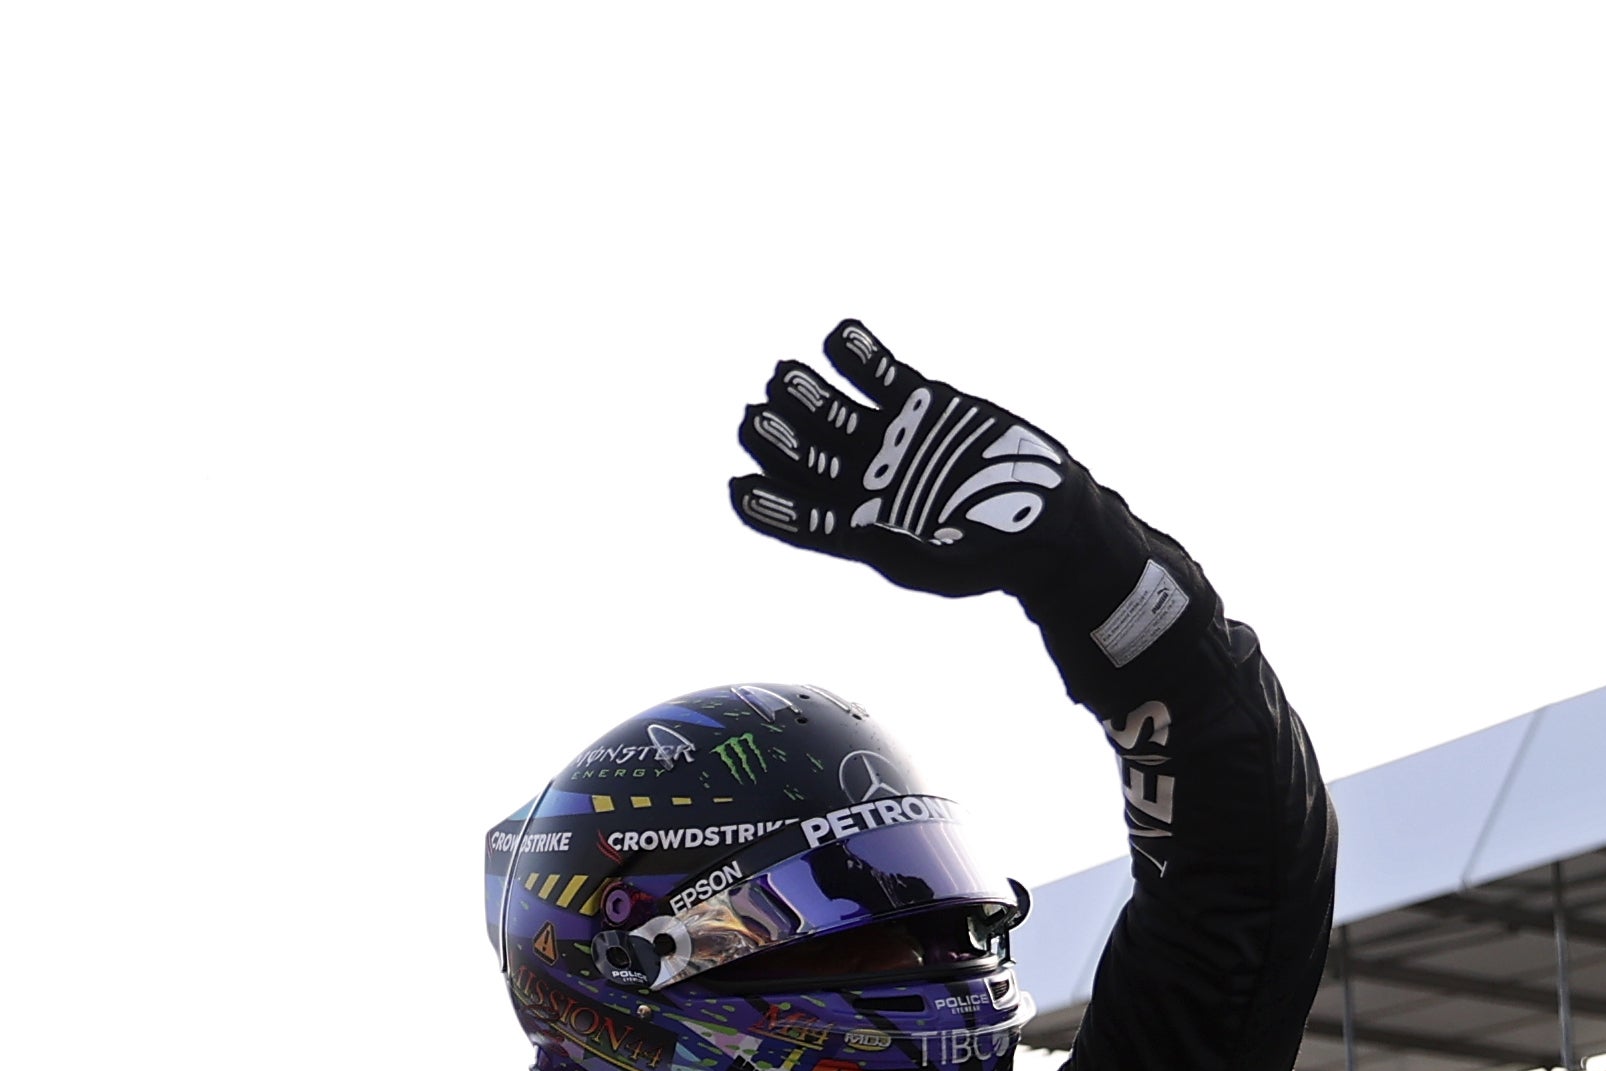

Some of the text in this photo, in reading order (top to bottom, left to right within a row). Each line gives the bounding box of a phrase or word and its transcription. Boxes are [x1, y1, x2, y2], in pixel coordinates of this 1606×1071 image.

[571, 769, 666, 780] ENERGY
[801, 796, 953, 848] PETRON
[669, 861, 745, 916] EPSON
[934, 993, 991, 1011] POLICE
